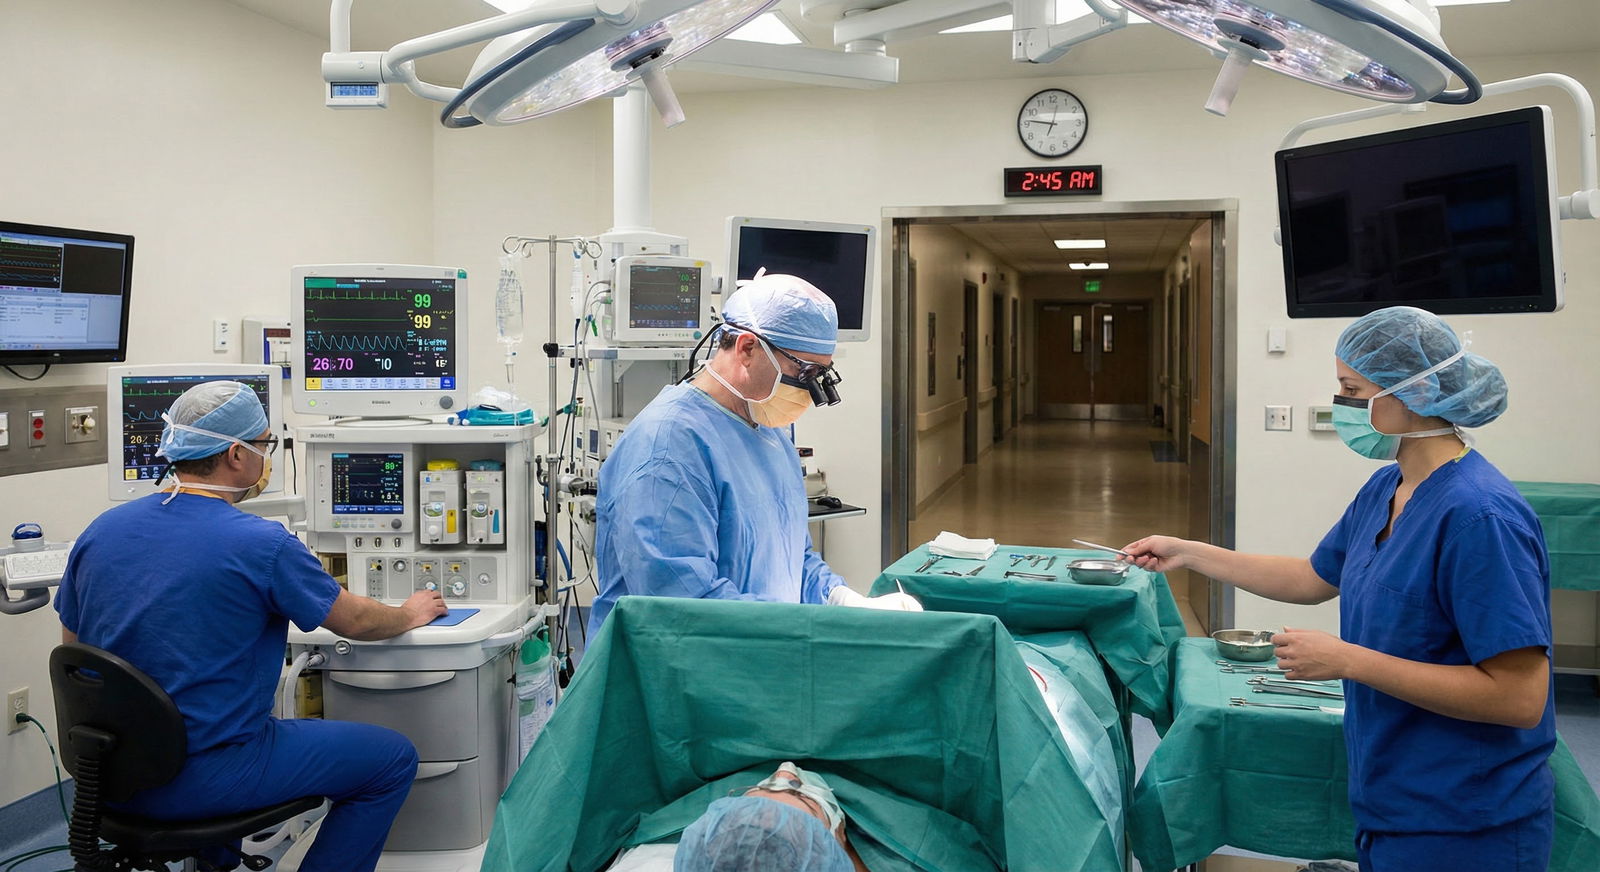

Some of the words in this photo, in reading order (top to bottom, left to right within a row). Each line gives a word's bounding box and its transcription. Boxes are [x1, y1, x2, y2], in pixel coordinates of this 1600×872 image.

[1037, 99, 1045, 107] 11
[1049, 95, 1058, 104] 12
[1064, 98, 1068, 106] 1
[1028, 108, 1038, 116] 10
[1071, 105, 1078, 113] 2
[1023, 120, 1031, 128] 9
[1075, 118, 1082, 127] 3
[1028, 132, 1034, 141] 8
[1071, 131, 1078, 139] 4
[1038, 140, 1044, 149] 7
[1049, 143, 1056, 152] 6
[1062, 140, 1069, 148] 5
[1022, 171, 1062, 191] 2:45
[1069, 171, 1095, 188] AM
[414, 294, 432, 308] 99
[414, 314, 432, 329] 99
[312, 357, 330, 371] 26
[337, 357, 354, 371] 70
